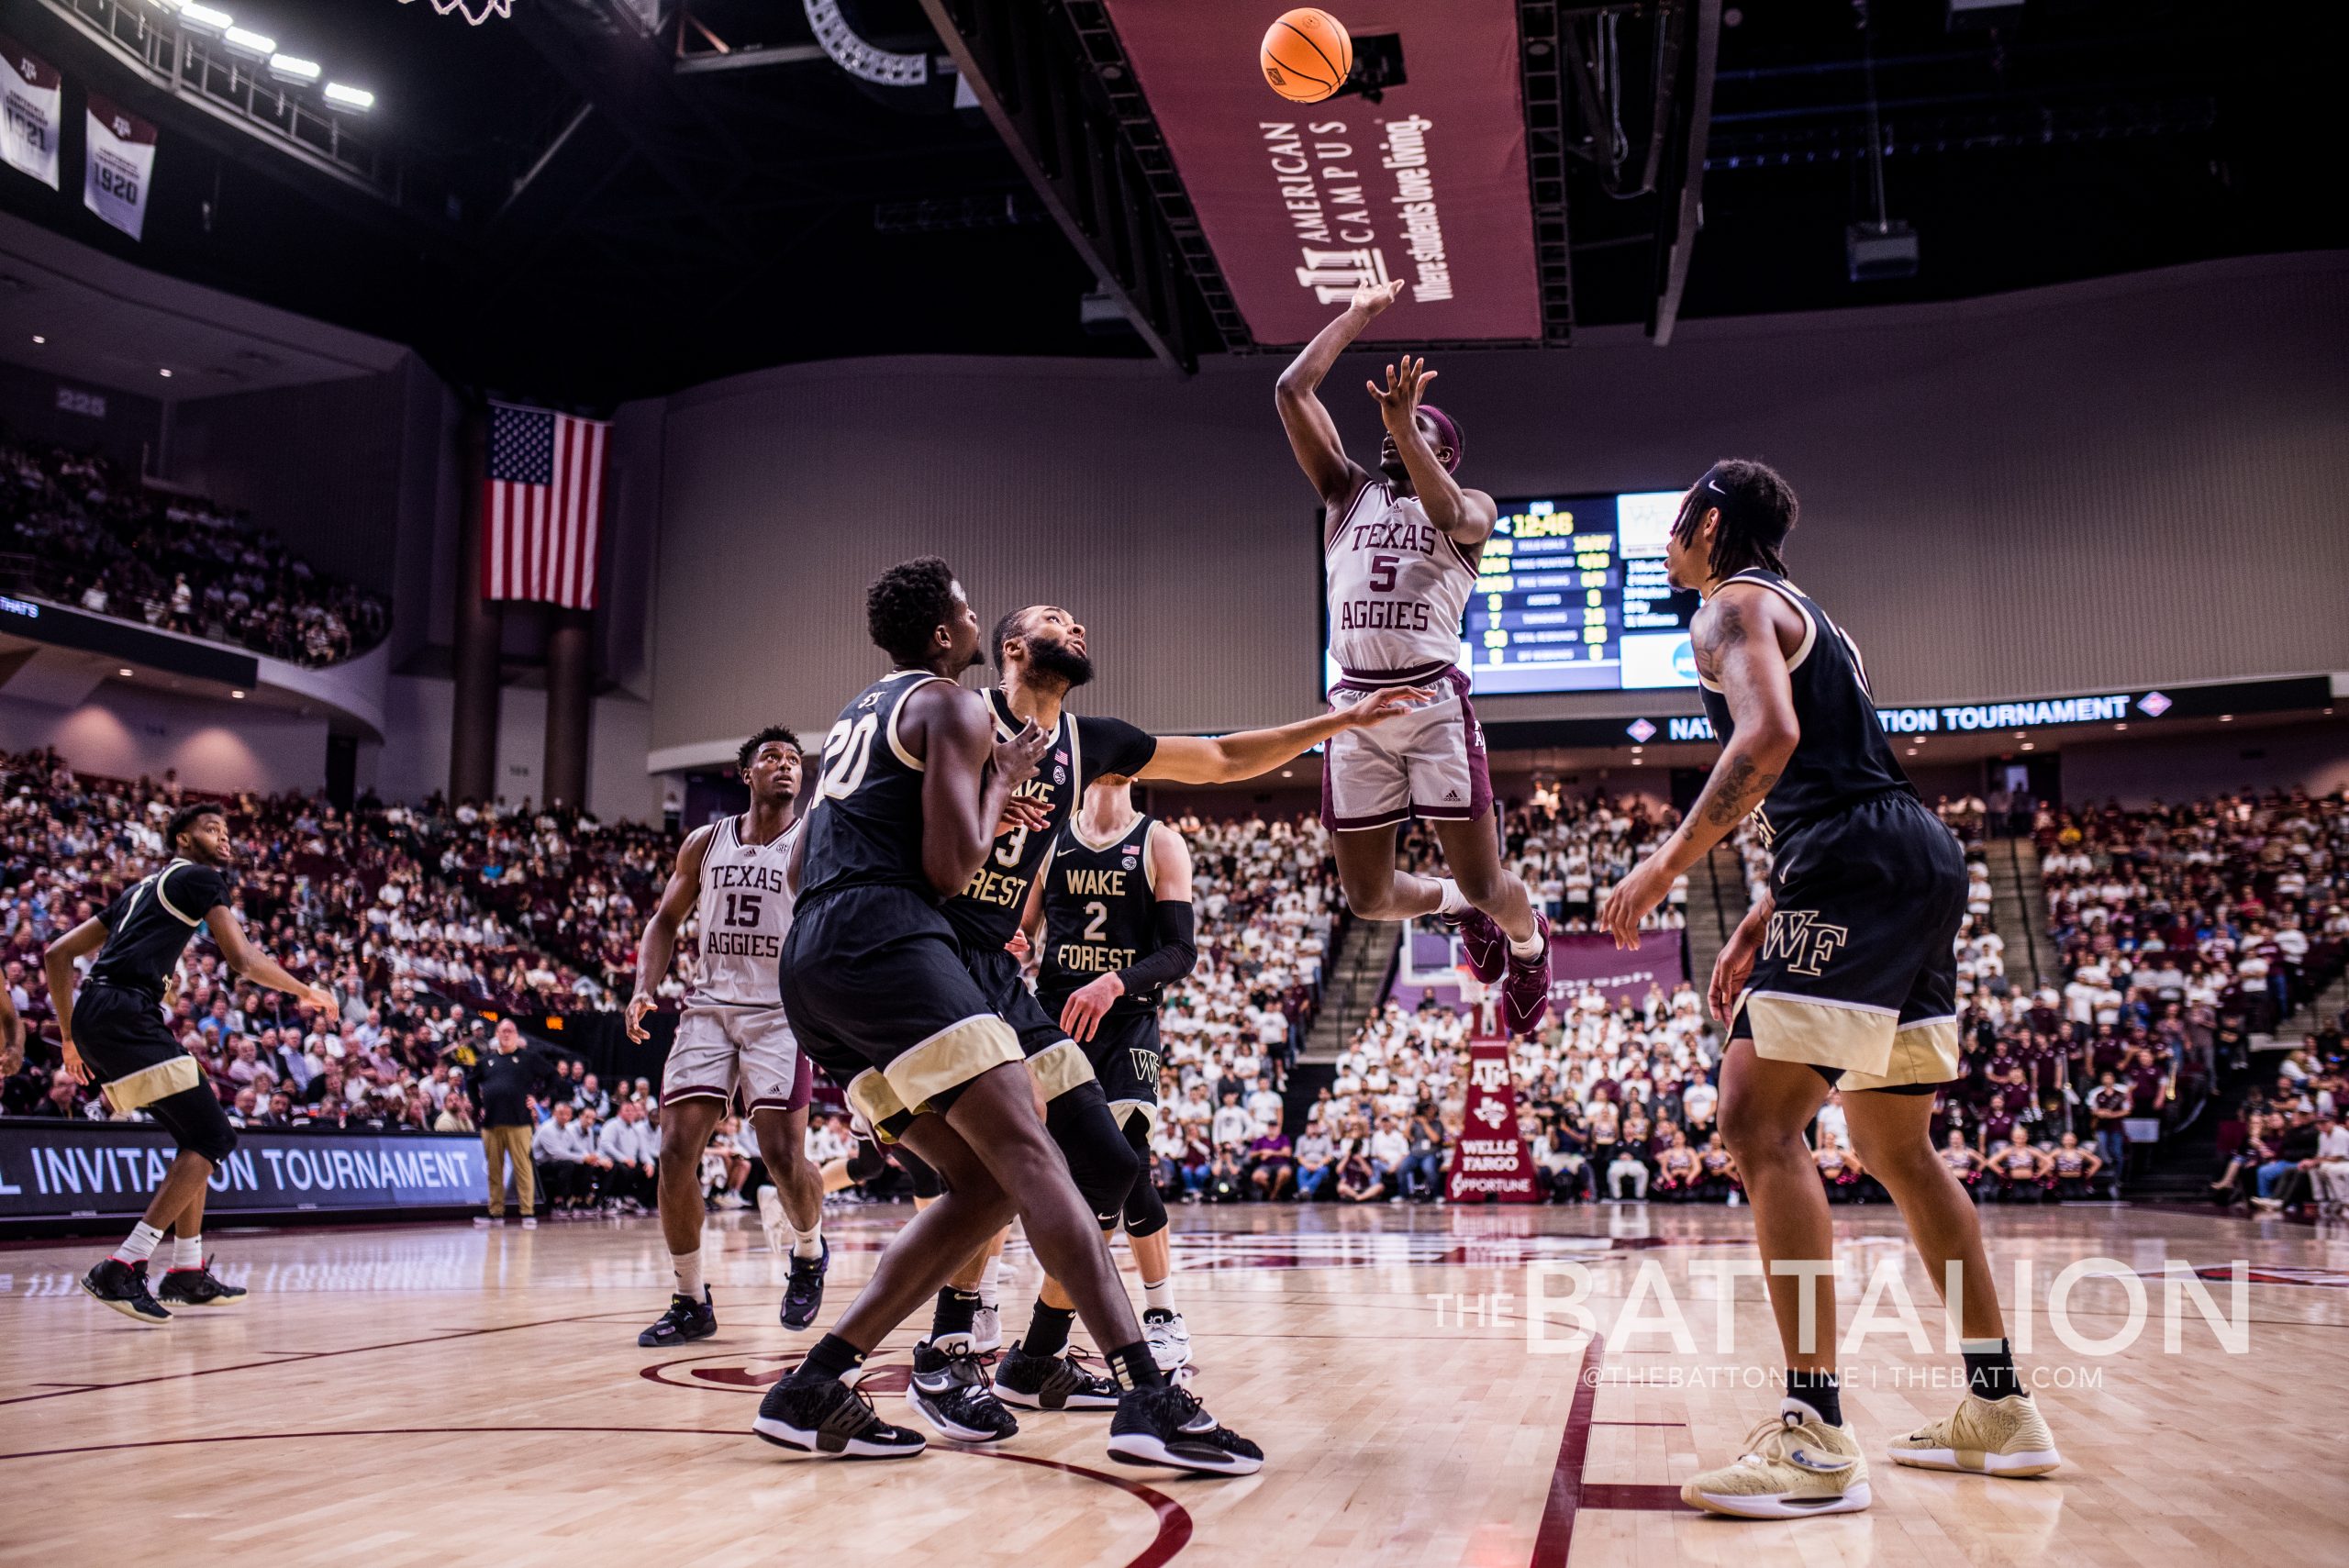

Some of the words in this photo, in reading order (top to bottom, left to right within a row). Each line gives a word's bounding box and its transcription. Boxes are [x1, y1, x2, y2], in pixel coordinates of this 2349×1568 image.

[1378, 114, 1433, 169] living.
[94, 161, 139, 206] 1920
[1259, 121, 1331, 244] AMERICAN
[1308, 121, 1375, 244] CAMPUS
[1390, 167, 1434, 204] love
[1397, 201, 1446, 263] students
[1411, 261, 1454, 303] Where
[1352, 522, 1437, 557] TEXAS
[1369, 555, 1400, 592] 5
[1341, 600, 1431, 632] AGGIES
[1942, 695, 2131, 731] TOURNAMENT
[811, 712, 878, 810] 20
[711, 864, 783, 895] TEXAS
[1066, 869, 1127, 896] WAKE
[724, 893, 763, 929] 15
[1084, 901, 1107, 941] 2
[707, 931, 780, 959] AGGIES
[1057, 943, 1137, 973] FOREST
[1461, 1139, 1519, 1155] WELLS
[1462, 1156, 1520, 1172] FARGO
[30, 1147, 259, 1194] INVITAON
[261, 1148, 471, 1191] TOURNAMENT
